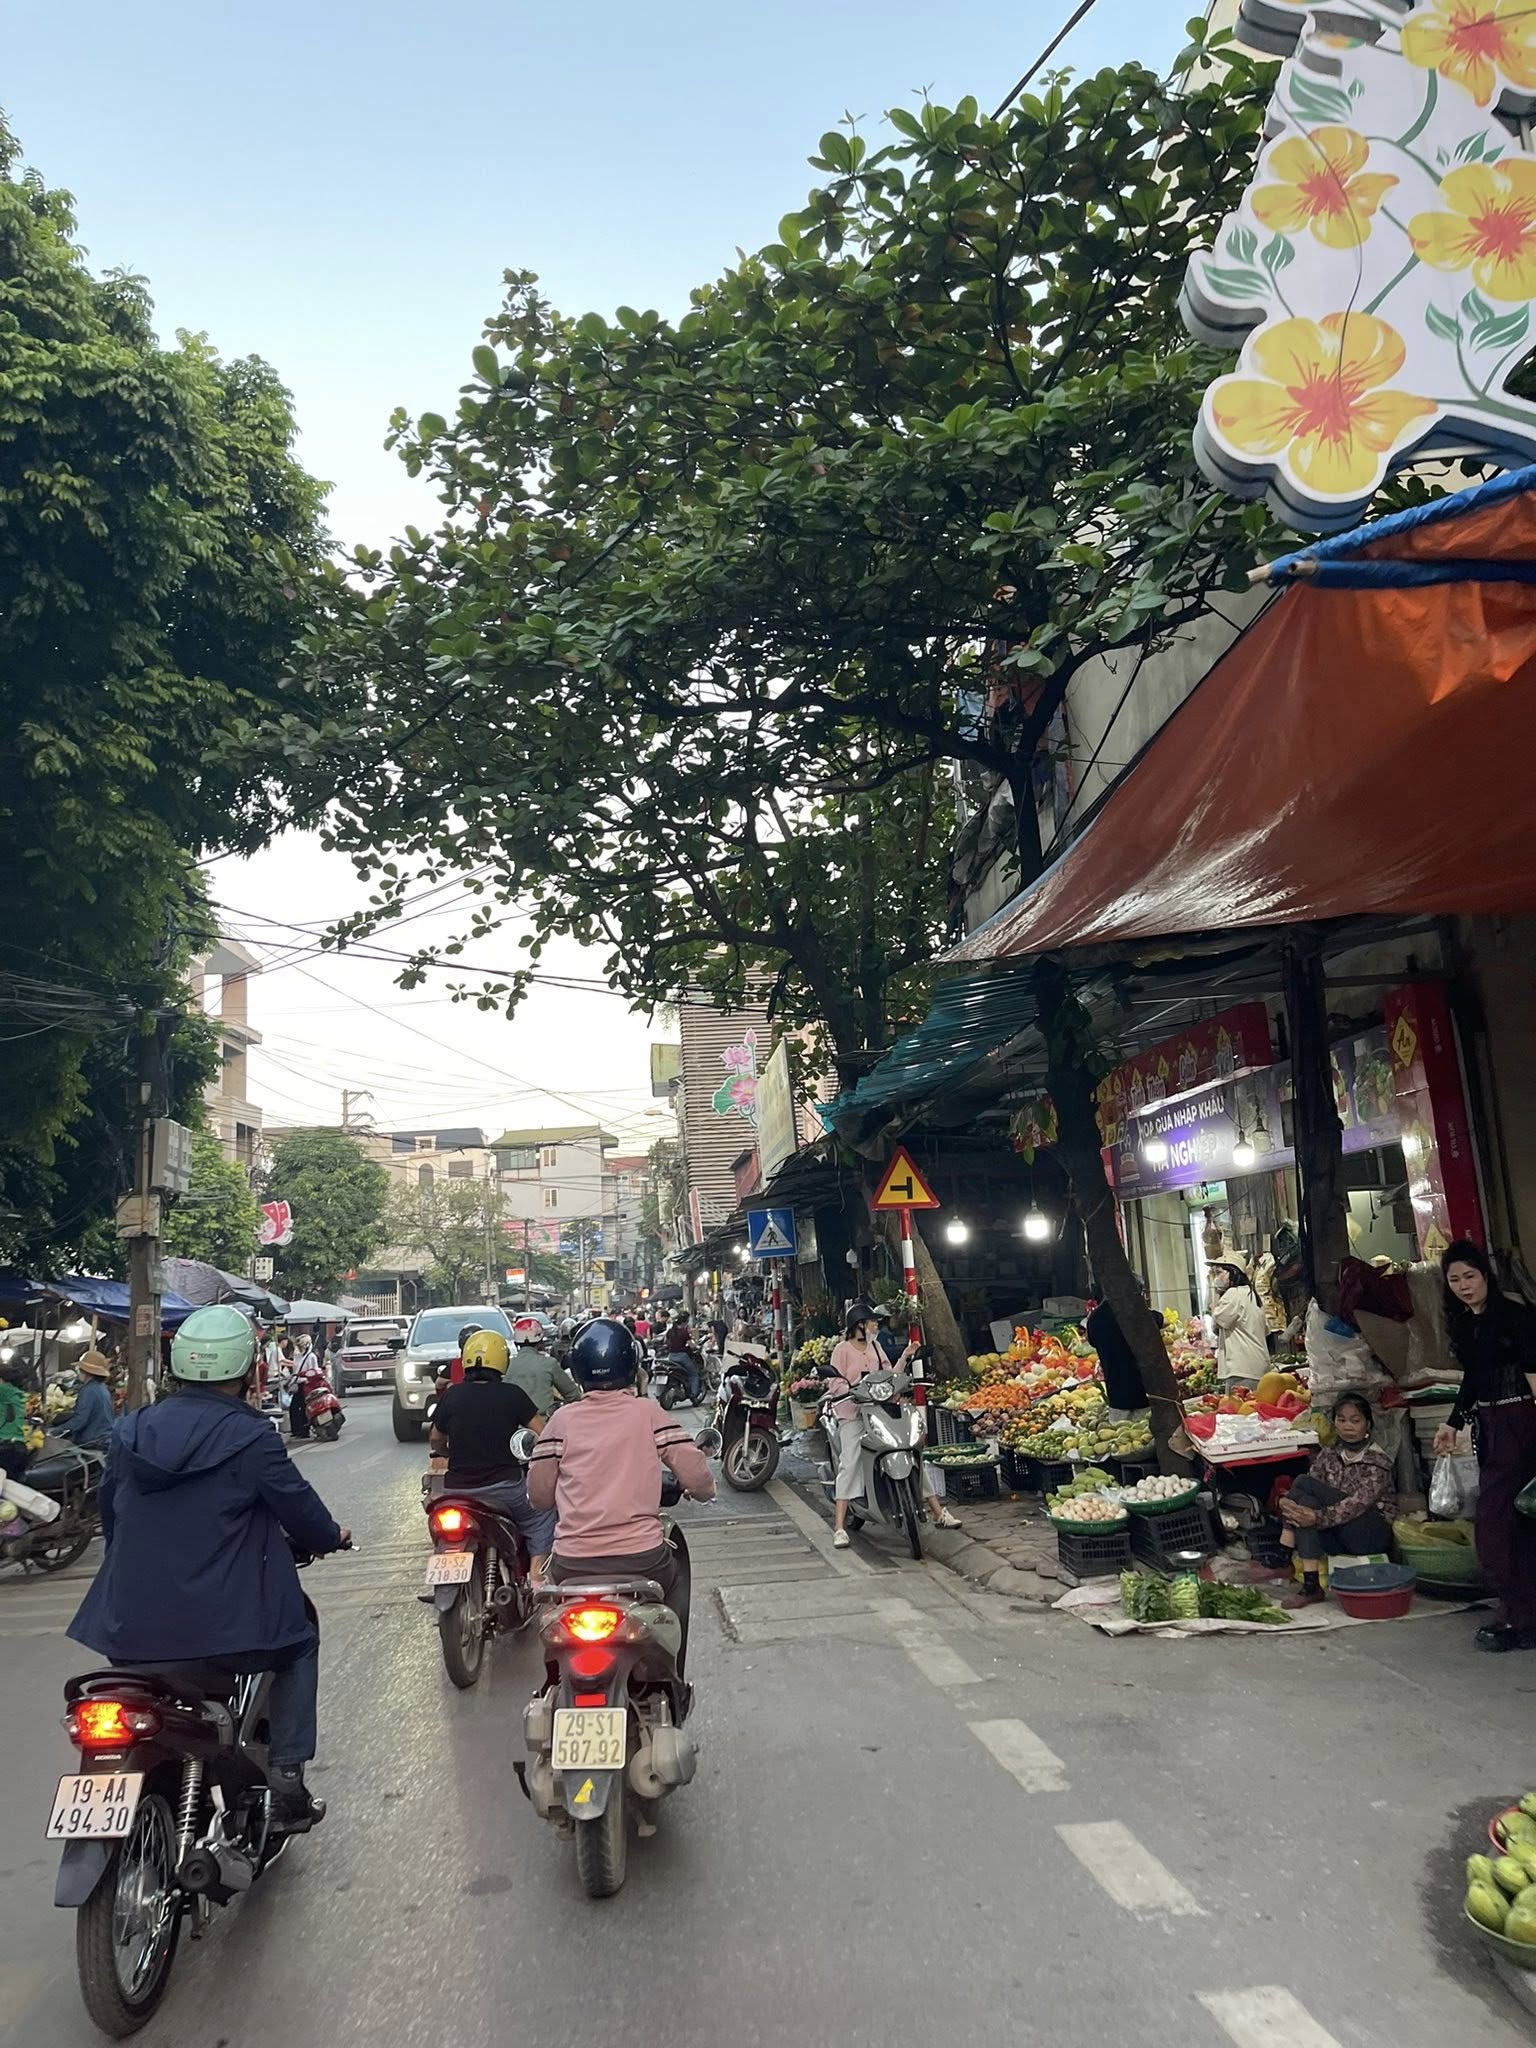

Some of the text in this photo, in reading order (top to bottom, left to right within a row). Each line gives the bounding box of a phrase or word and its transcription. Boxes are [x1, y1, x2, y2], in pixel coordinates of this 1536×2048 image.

[1173, 1103, 1198, 1128] NHẬP
[428, 1569, 468, 1583] 218.30
[565, 1714, 614, 1737] 29-S1
[558, 1739, 621, 1764] 587.92
[72, 1778, 127, 1803] 19-AA
[54, 1807, 129, 1834] 494.30
